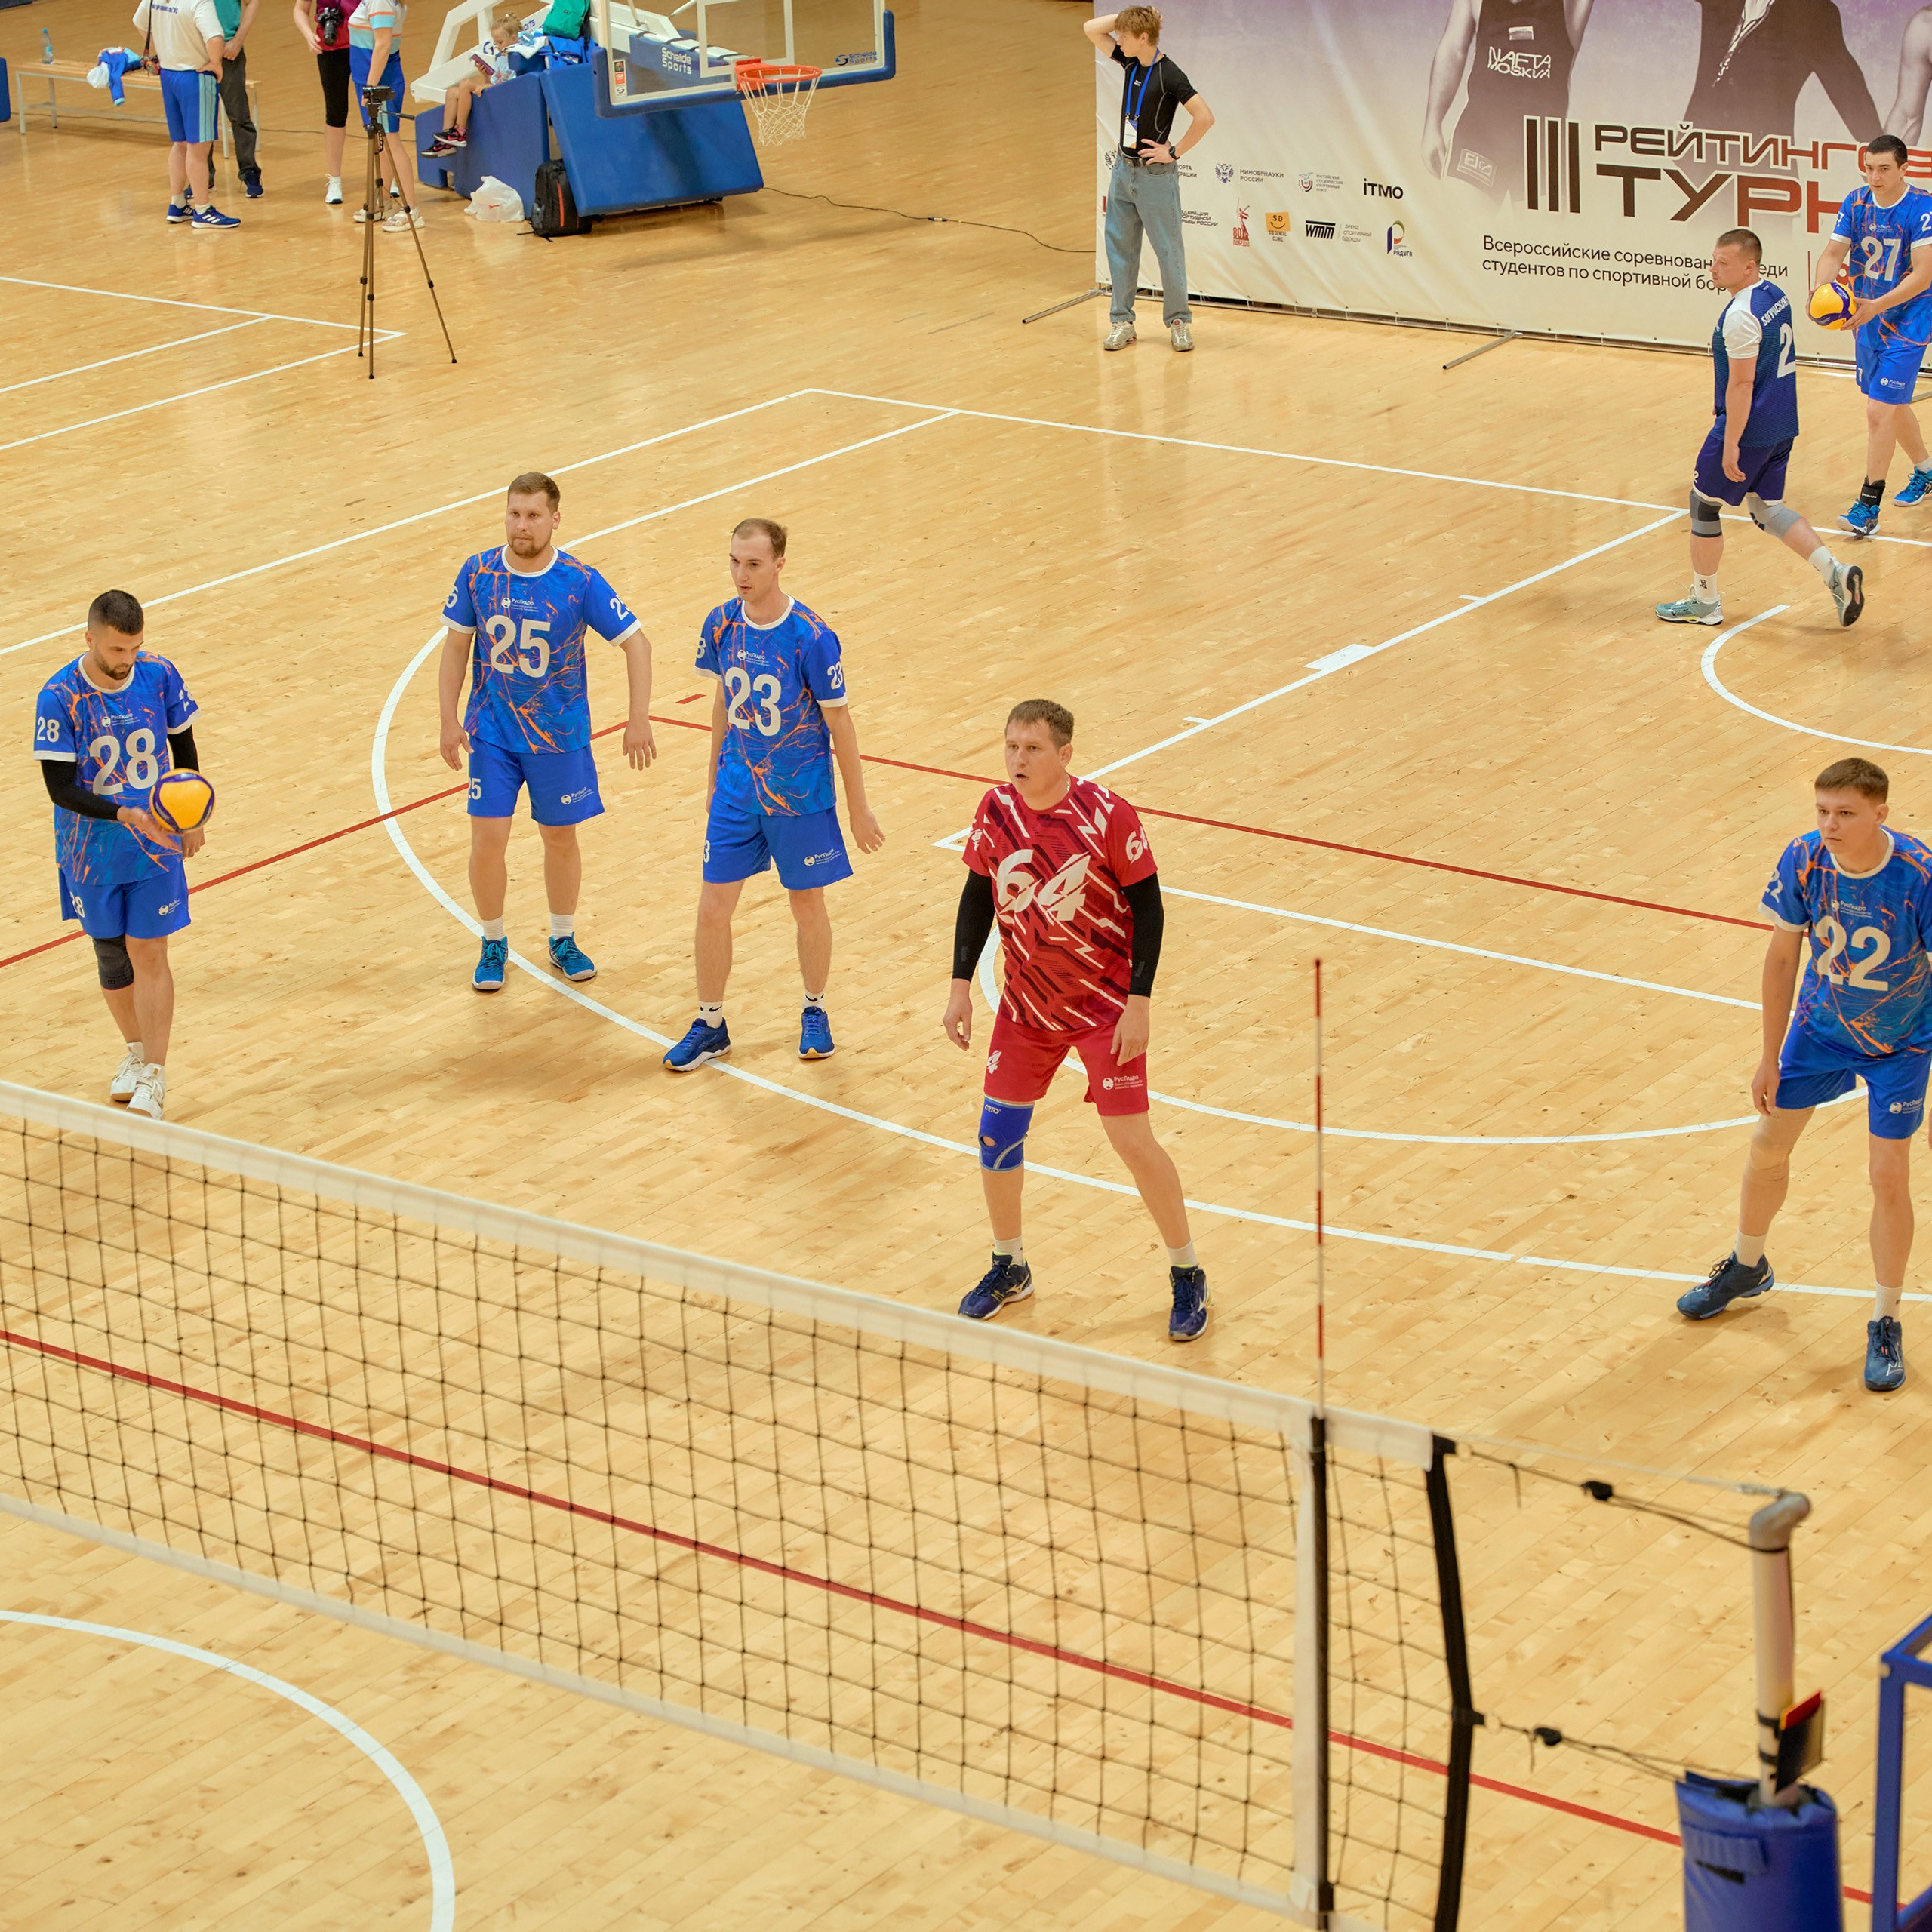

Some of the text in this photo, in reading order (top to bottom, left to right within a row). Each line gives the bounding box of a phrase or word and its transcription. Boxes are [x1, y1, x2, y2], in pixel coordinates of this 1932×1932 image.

[662, 57, 692, 75] Sports
[1488, 46, 1552, 69] NAFTA
[1240, 169, 1284, 178] МИНОБРНАУКИ
[1232, 227, 1242, 239] 80
[1919, 211, 1932, 232] 2
[1483, 235, 1611, 261] Всероссийские
[1614, 251, 1713, 271] соревнован
[1860, 235, 1902, 281] 27
[1481, 257, 1564, 277] студентов
[1568, 265, 1589, 278] по
[1592, 269, 1692, 288] спортивной
[1777, 322, 1796, 378] 2
[485, 614, 551, 678] 25
[826, 661, 844, 691] 23
[724, 666, 782, 737] 23
[36, 715, 60, 743] 28
[89, 728, 158, 795] 28
[996, 848, 1091, 921] 64
[1814, 915, 1892, 992] 22
[1113, 1075, 1140, 1083] РусГидро
